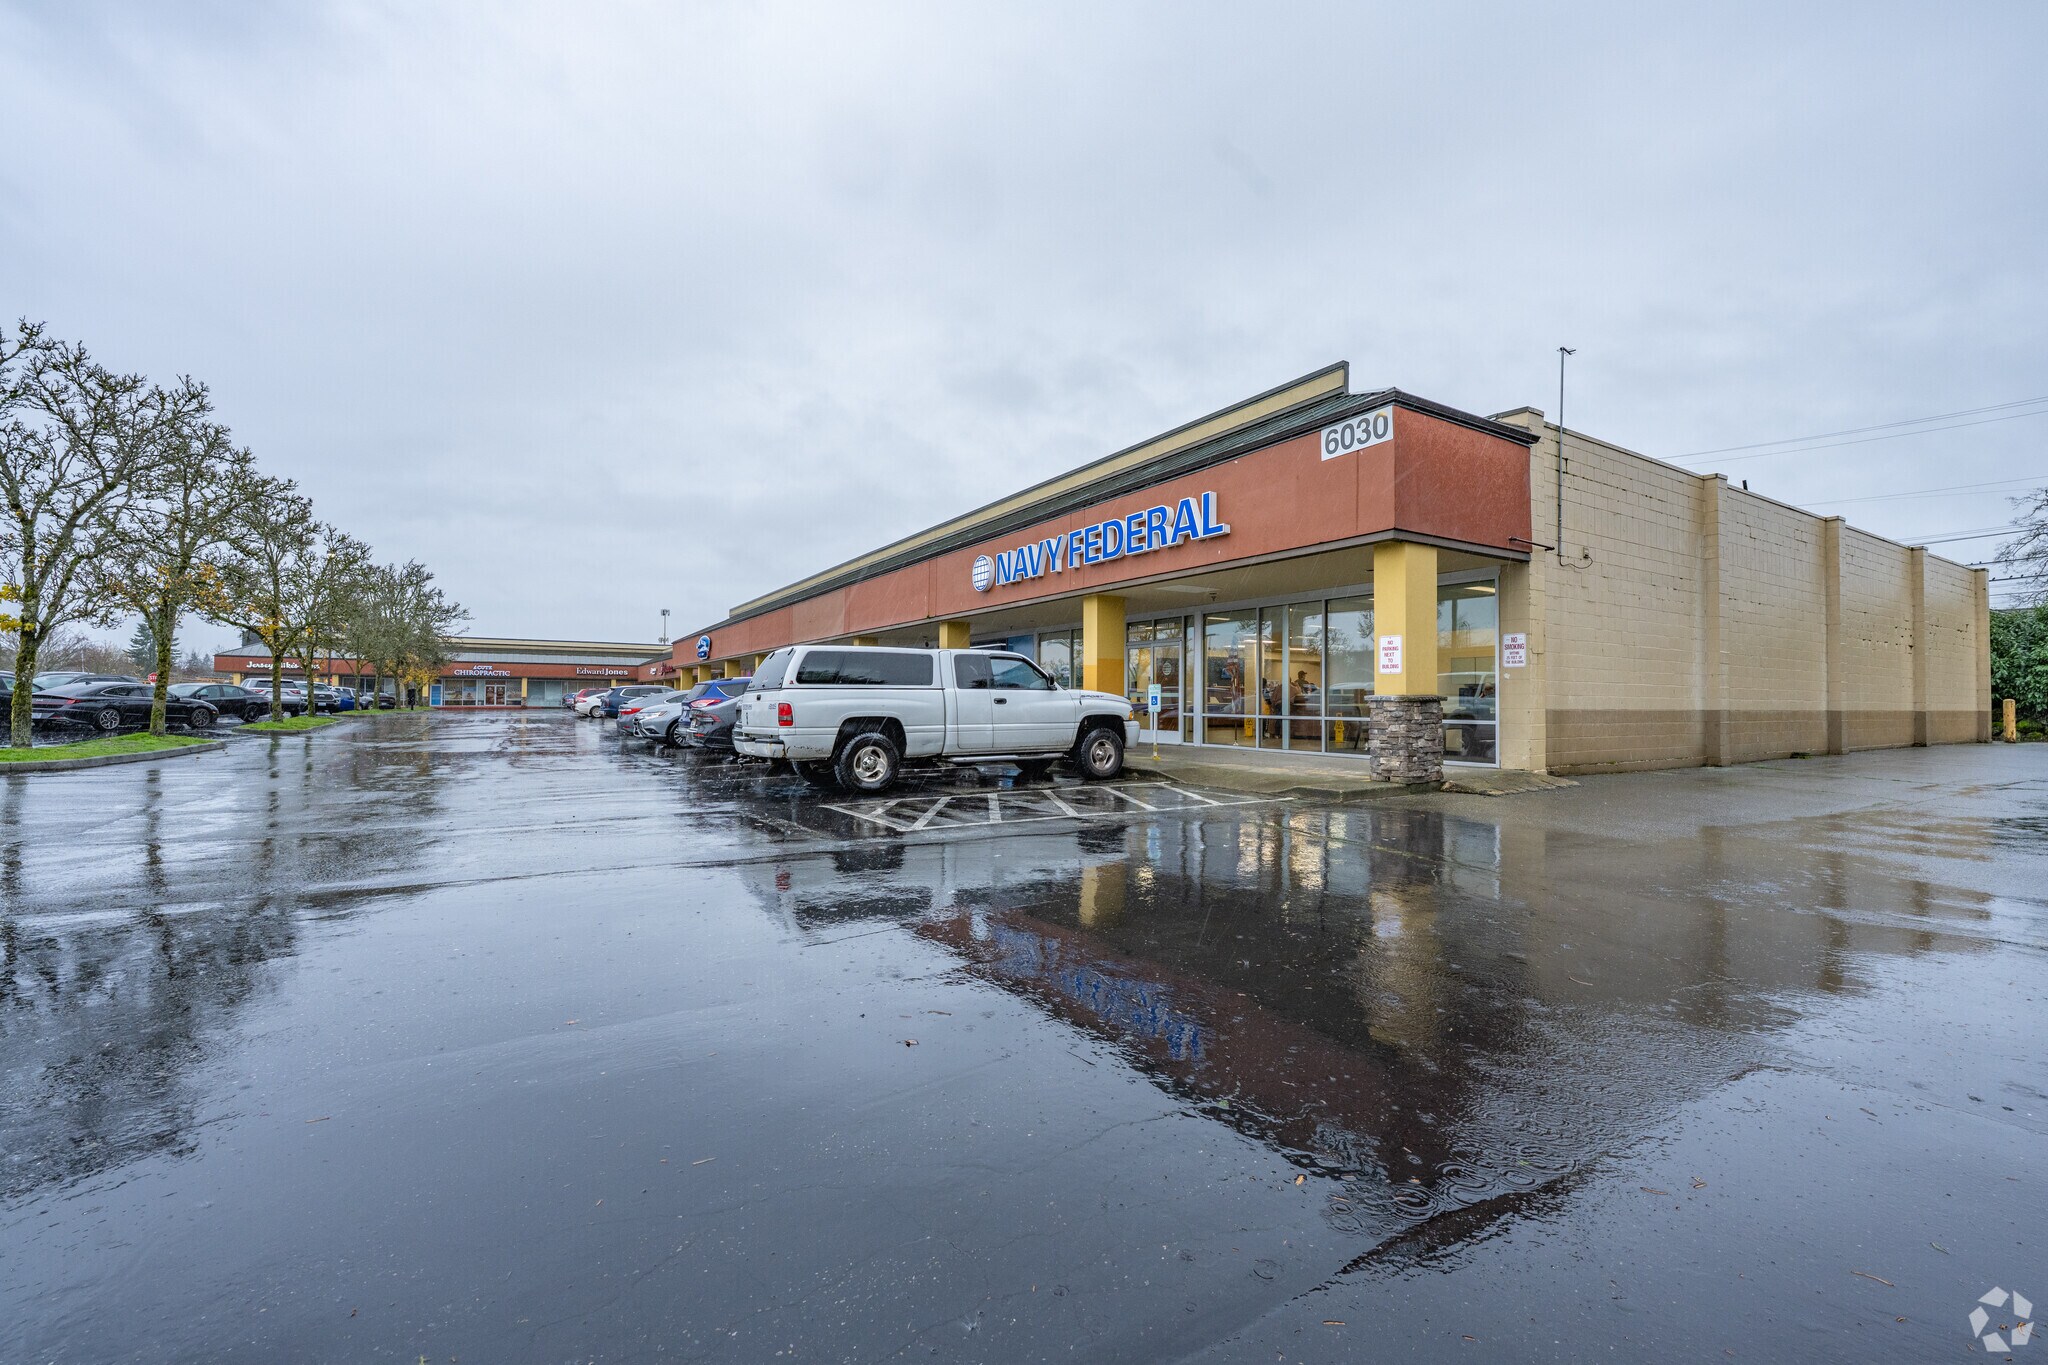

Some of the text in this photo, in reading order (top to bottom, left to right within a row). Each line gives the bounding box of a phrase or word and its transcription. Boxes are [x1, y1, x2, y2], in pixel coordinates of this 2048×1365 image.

[1324, 411, 1389, 455] 6030
[996, 491, 1230, 586] NAVY FEDERAL
[246, 661, 274, 670] Jersey
[454, 669, 511, 677] CHIROPRACTIC
[576, 667, 628, 676] Edward Jones
